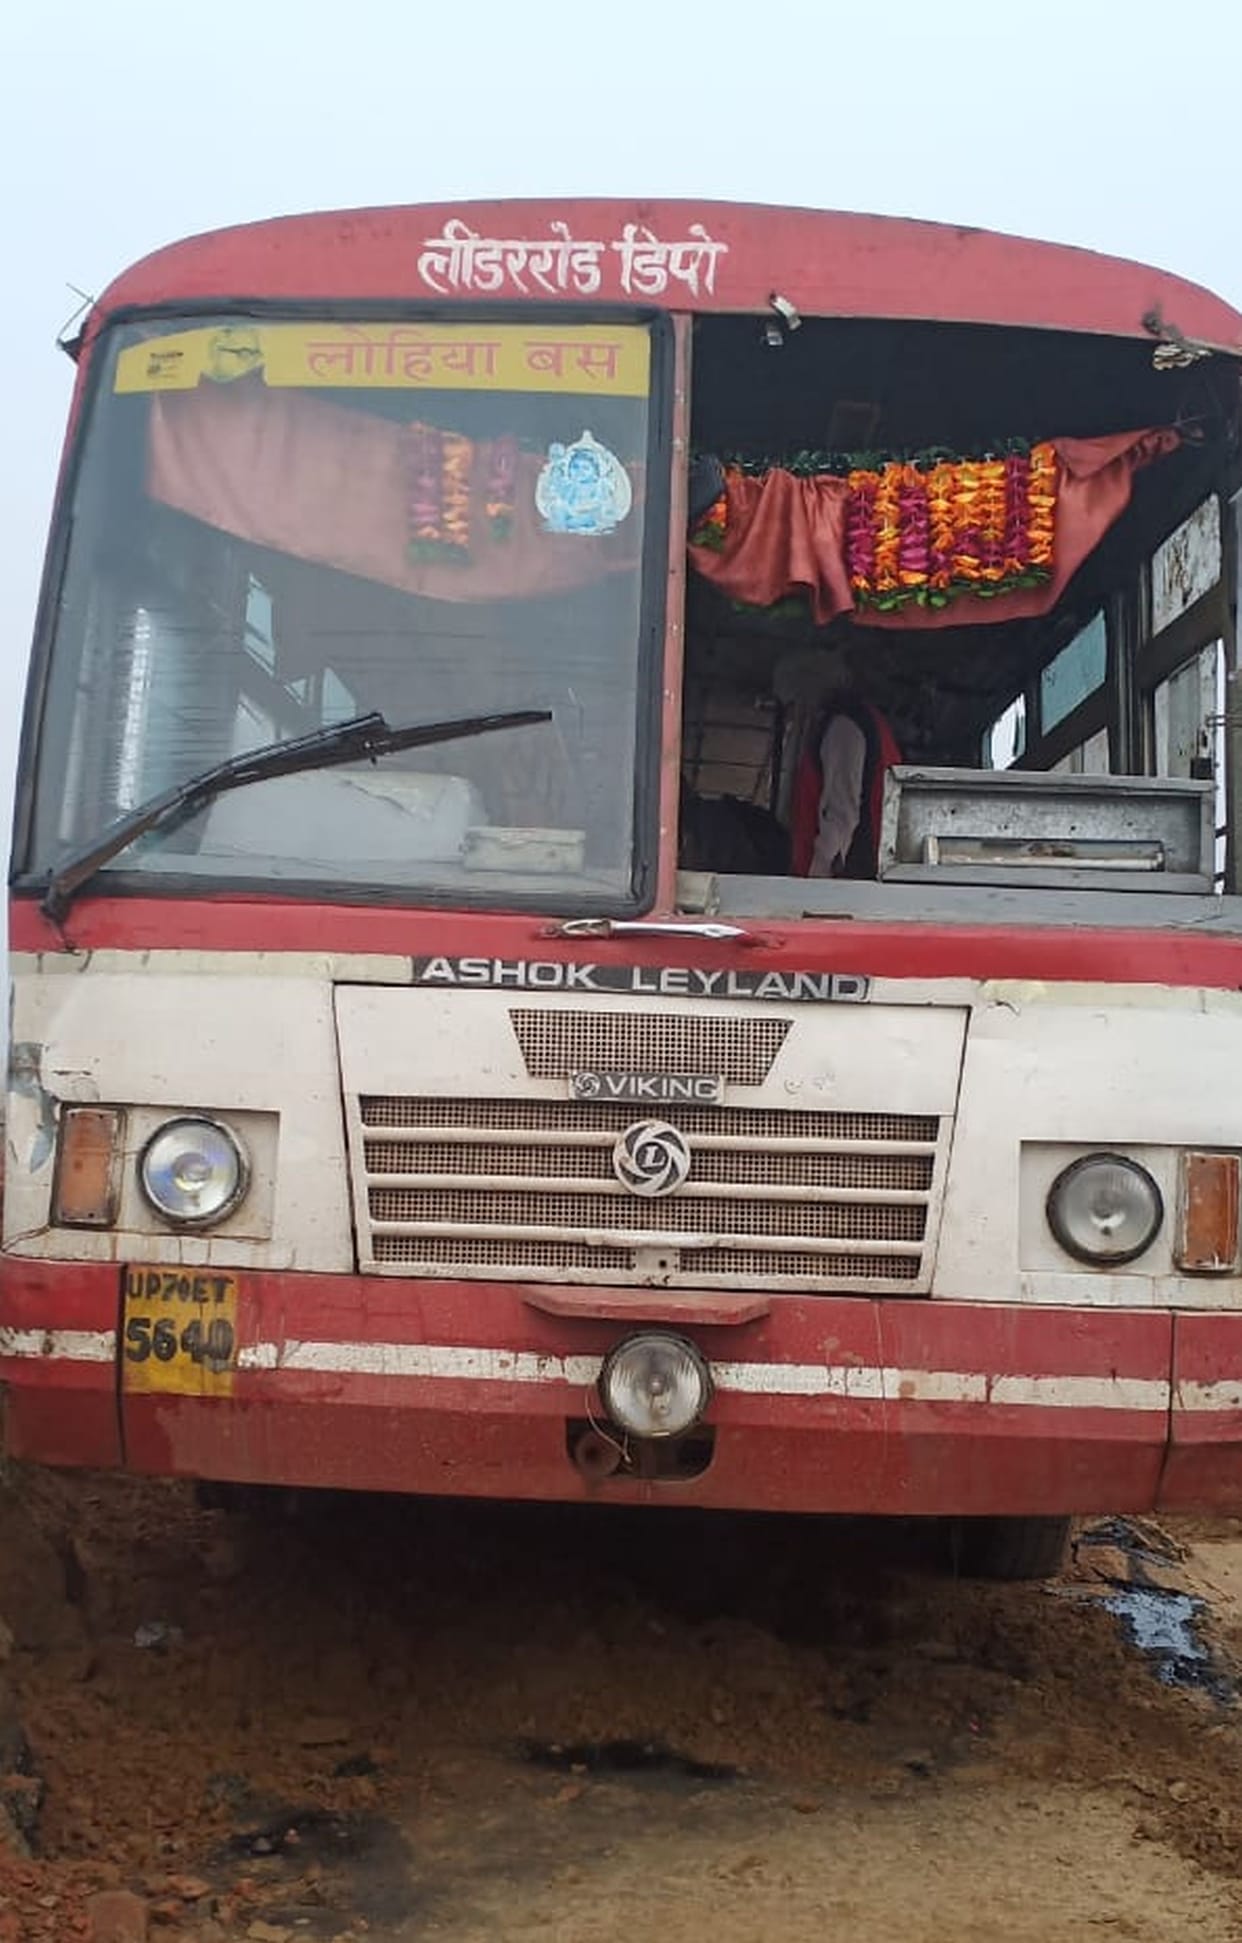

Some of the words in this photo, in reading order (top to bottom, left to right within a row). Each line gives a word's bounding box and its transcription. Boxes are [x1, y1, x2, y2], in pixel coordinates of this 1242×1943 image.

[611, 222, 729, 296] डिपो
[306, 324, 502, 382] लोहिया
[523, 340, 622, 380] बस
[421, 957, 599, 990] ASHOK
[632, 965, 866, 1001] LEYLAND
[605, 1075, 718, 1098] VIKING
[127, 1271, 235, 1304] UP70ET
[126, 1317, 234, 1366] 5640
